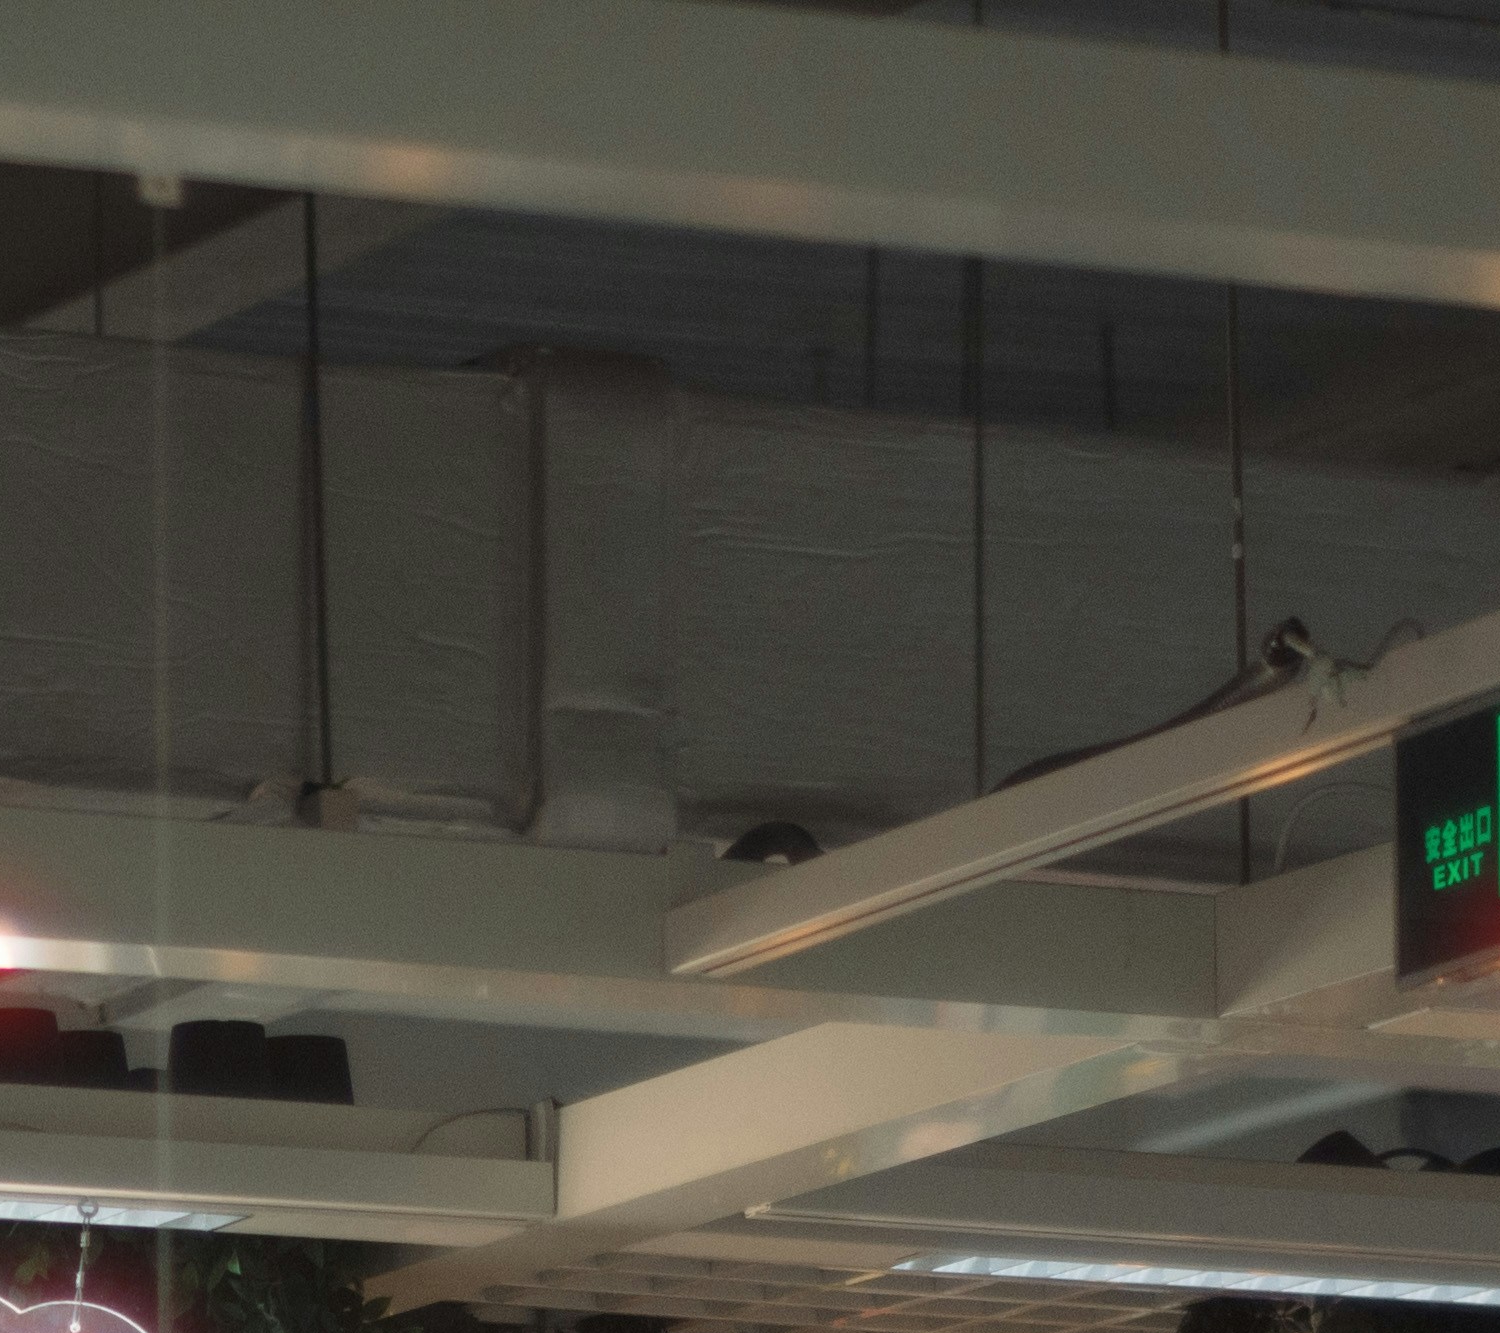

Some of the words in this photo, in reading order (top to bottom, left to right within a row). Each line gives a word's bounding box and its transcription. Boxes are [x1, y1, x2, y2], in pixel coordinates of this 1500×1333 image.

[1425, 806, 1491, 864] 安全出口
[1433, 851, 1484, 890] EXIT
